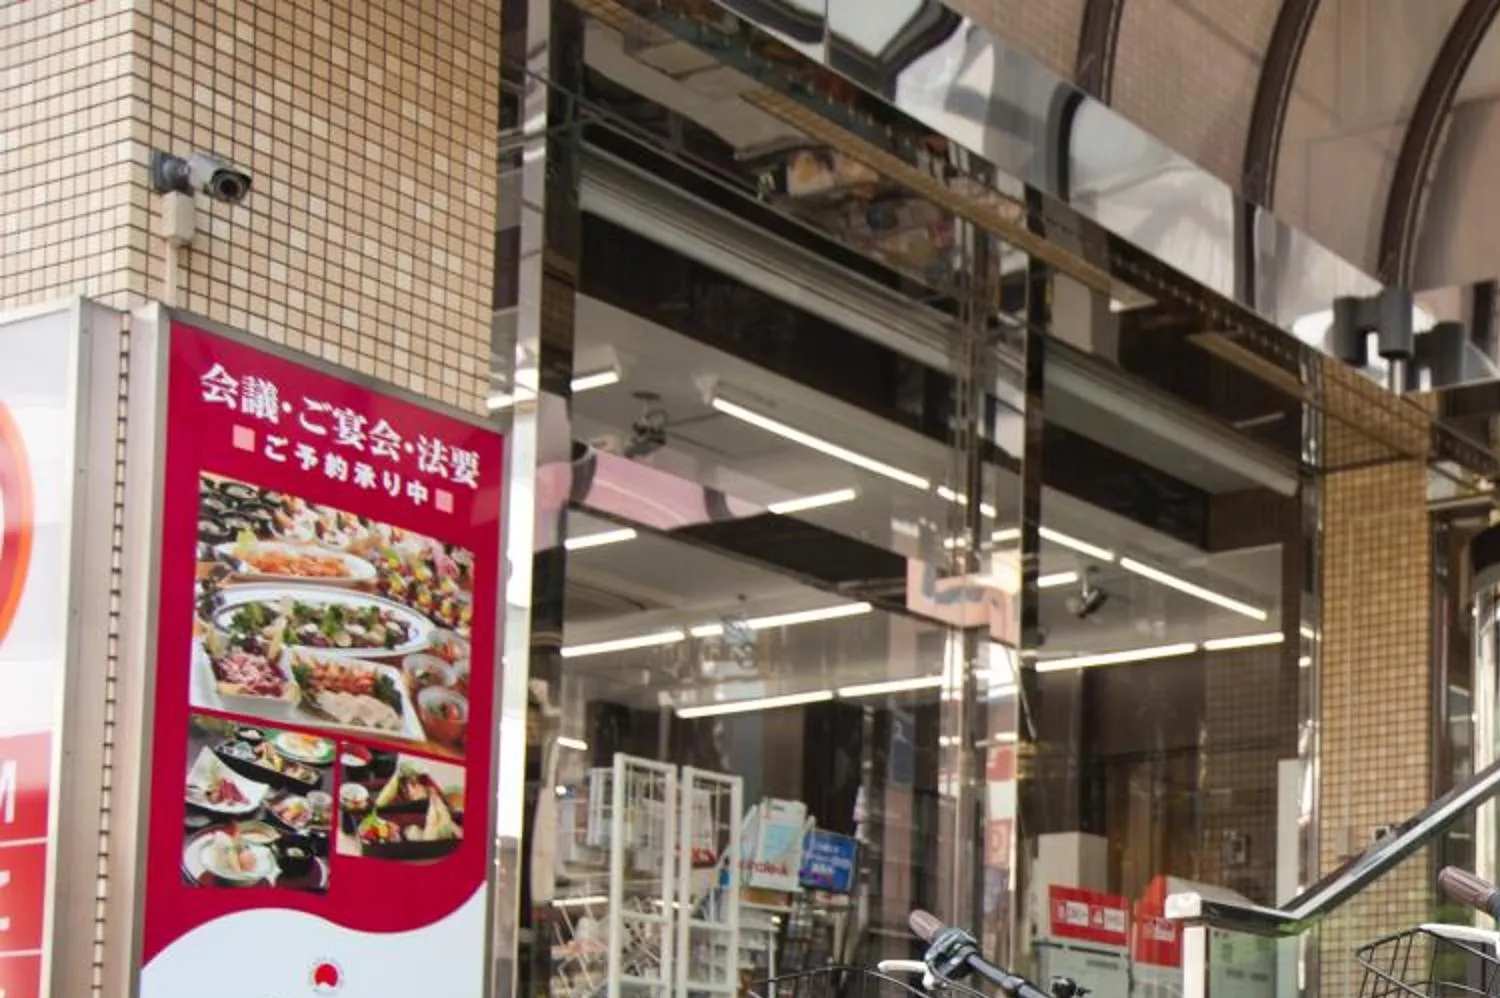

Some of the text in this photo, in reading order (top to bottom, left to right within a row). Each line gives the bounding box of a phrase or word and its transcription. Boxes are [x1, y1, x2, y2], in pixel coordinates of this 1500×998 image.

[200, 362, 480, 488] 会議・ご宴会・法要
[264, 434, 429, 506] ご予約承り中
